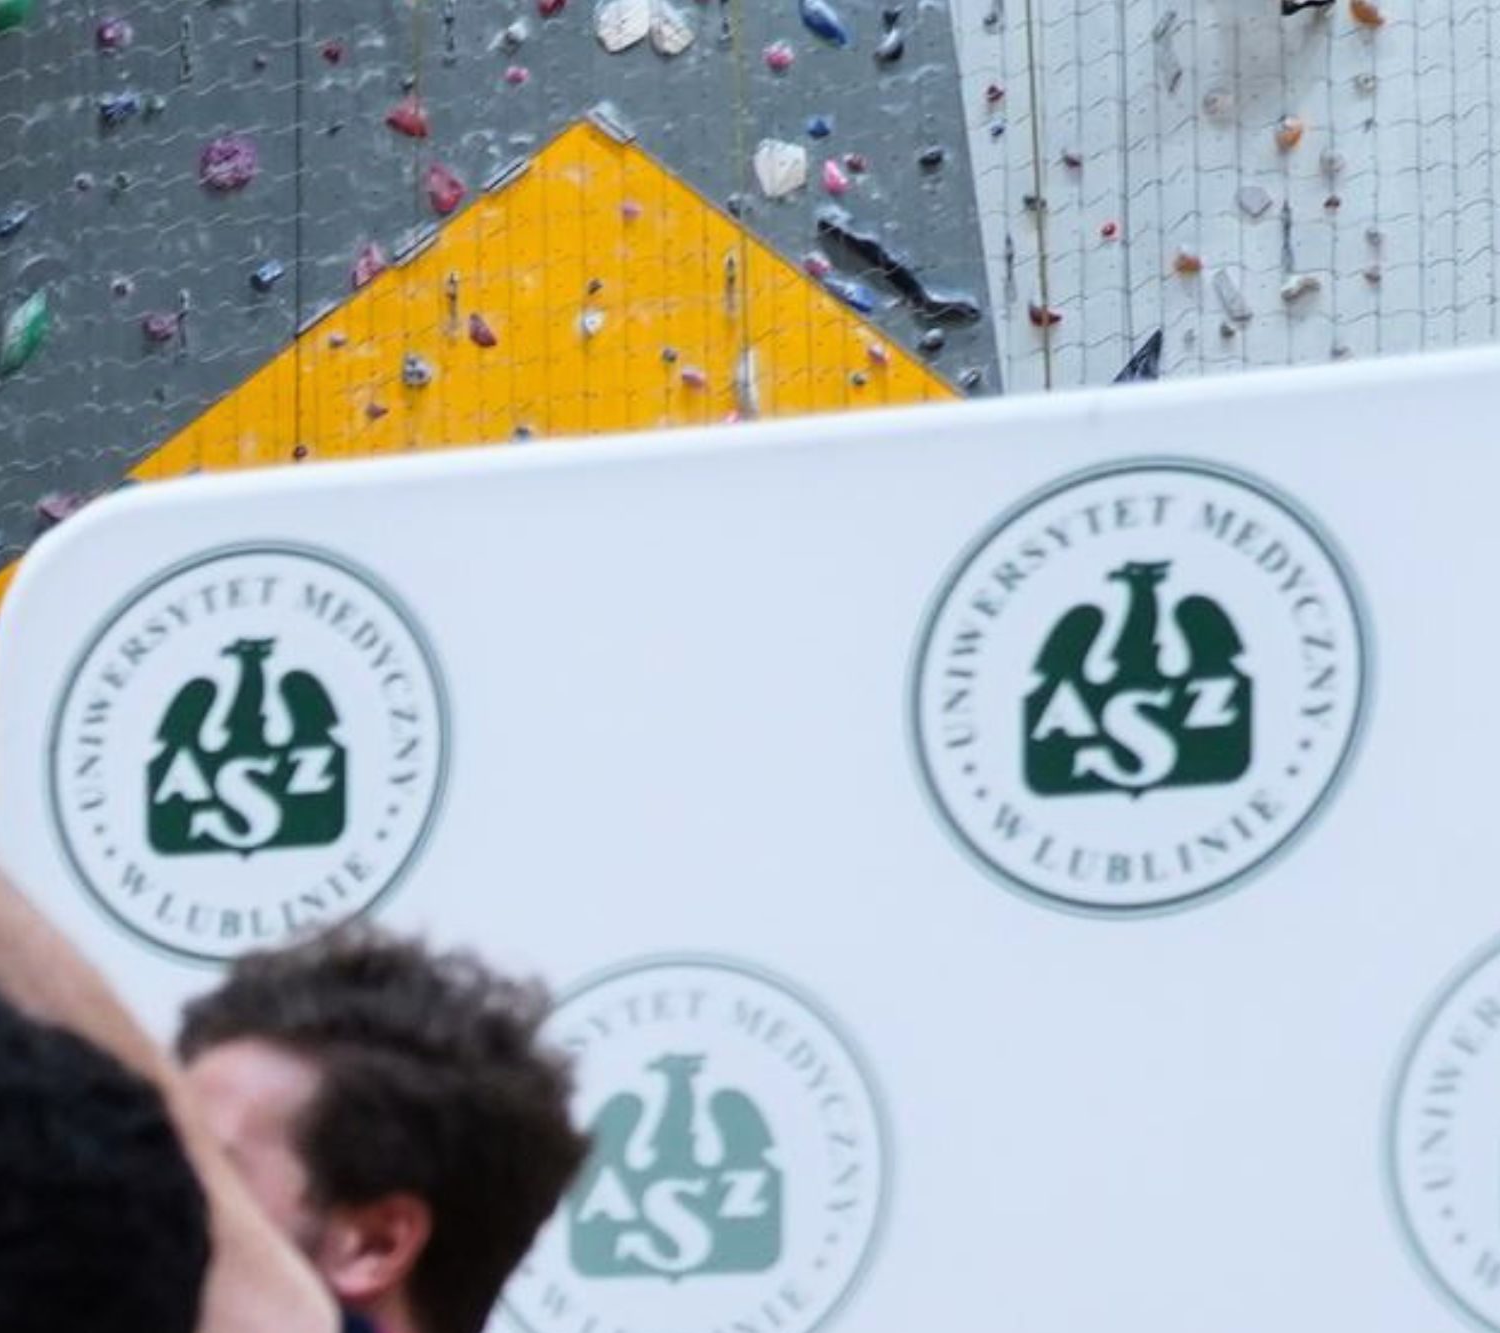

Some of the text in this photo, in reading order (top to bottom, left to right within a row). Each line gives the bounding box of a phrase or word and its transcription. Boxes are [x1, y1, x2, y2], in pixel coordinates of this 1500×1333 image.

[74, 575, 425, 815] UNIWERSYTET MEDYCZNY
[940, 493, 1343, 753] UNIWERSYTET MEDYCZNY
[118, 858, 160, 902] W
[985, 787, 1285, 887] W LUBLINIE
